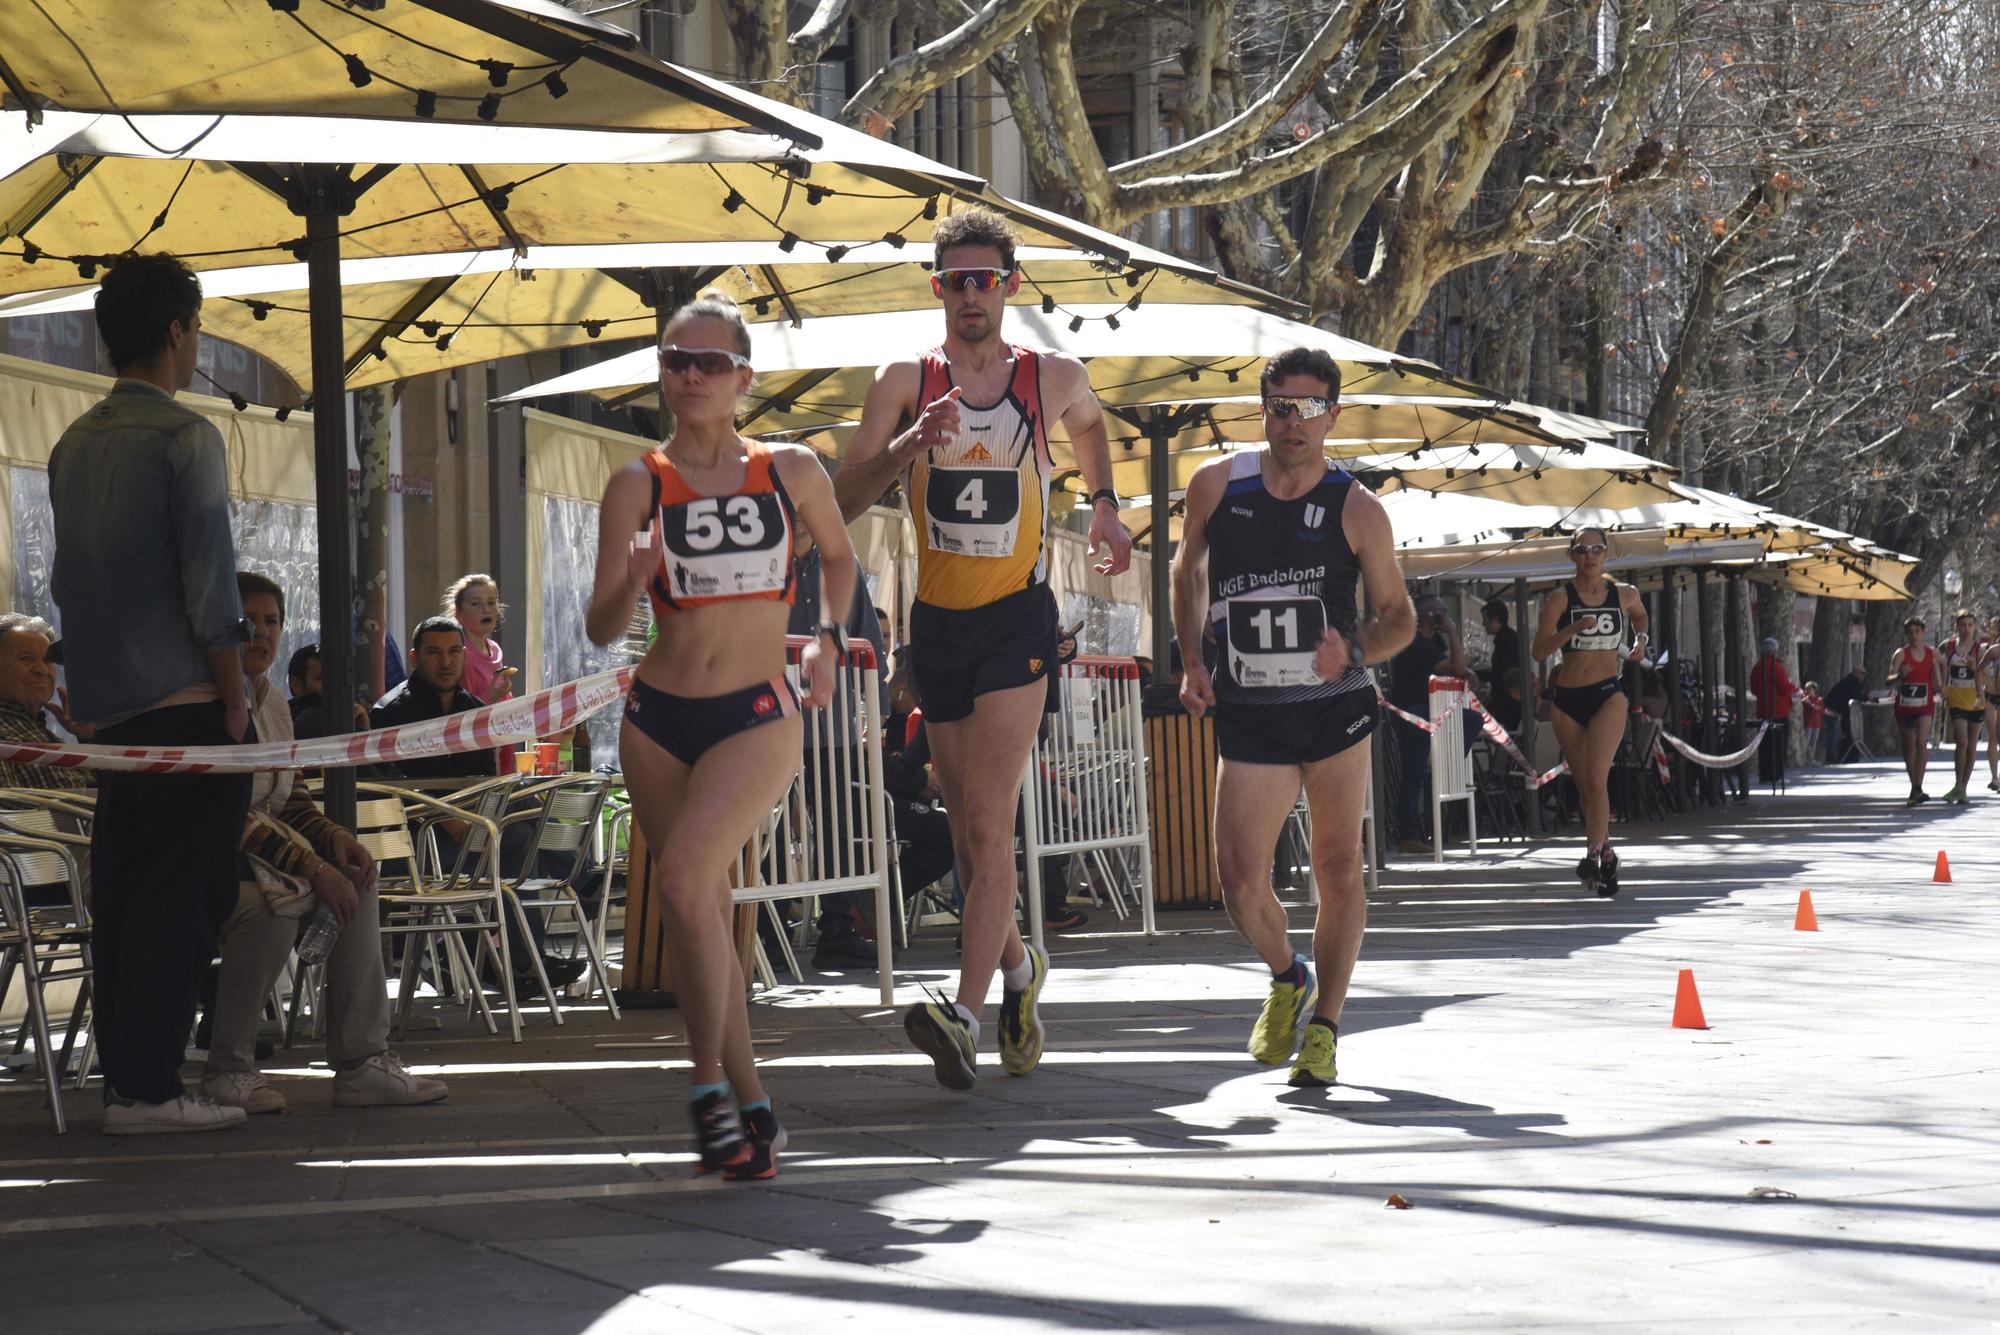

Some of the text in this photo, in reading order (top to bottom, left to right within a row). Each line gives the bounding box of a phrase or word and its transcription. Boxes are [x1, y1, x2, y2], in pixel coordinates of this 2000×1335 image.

[956, 478, 988, 519] 4
[685, 496, 765, 551] 53
[1219, 565, 1326, 598] UGE Badalona
[1250, 607, 1299, 649] 11
[1909, 686, 1919, 697] 7
